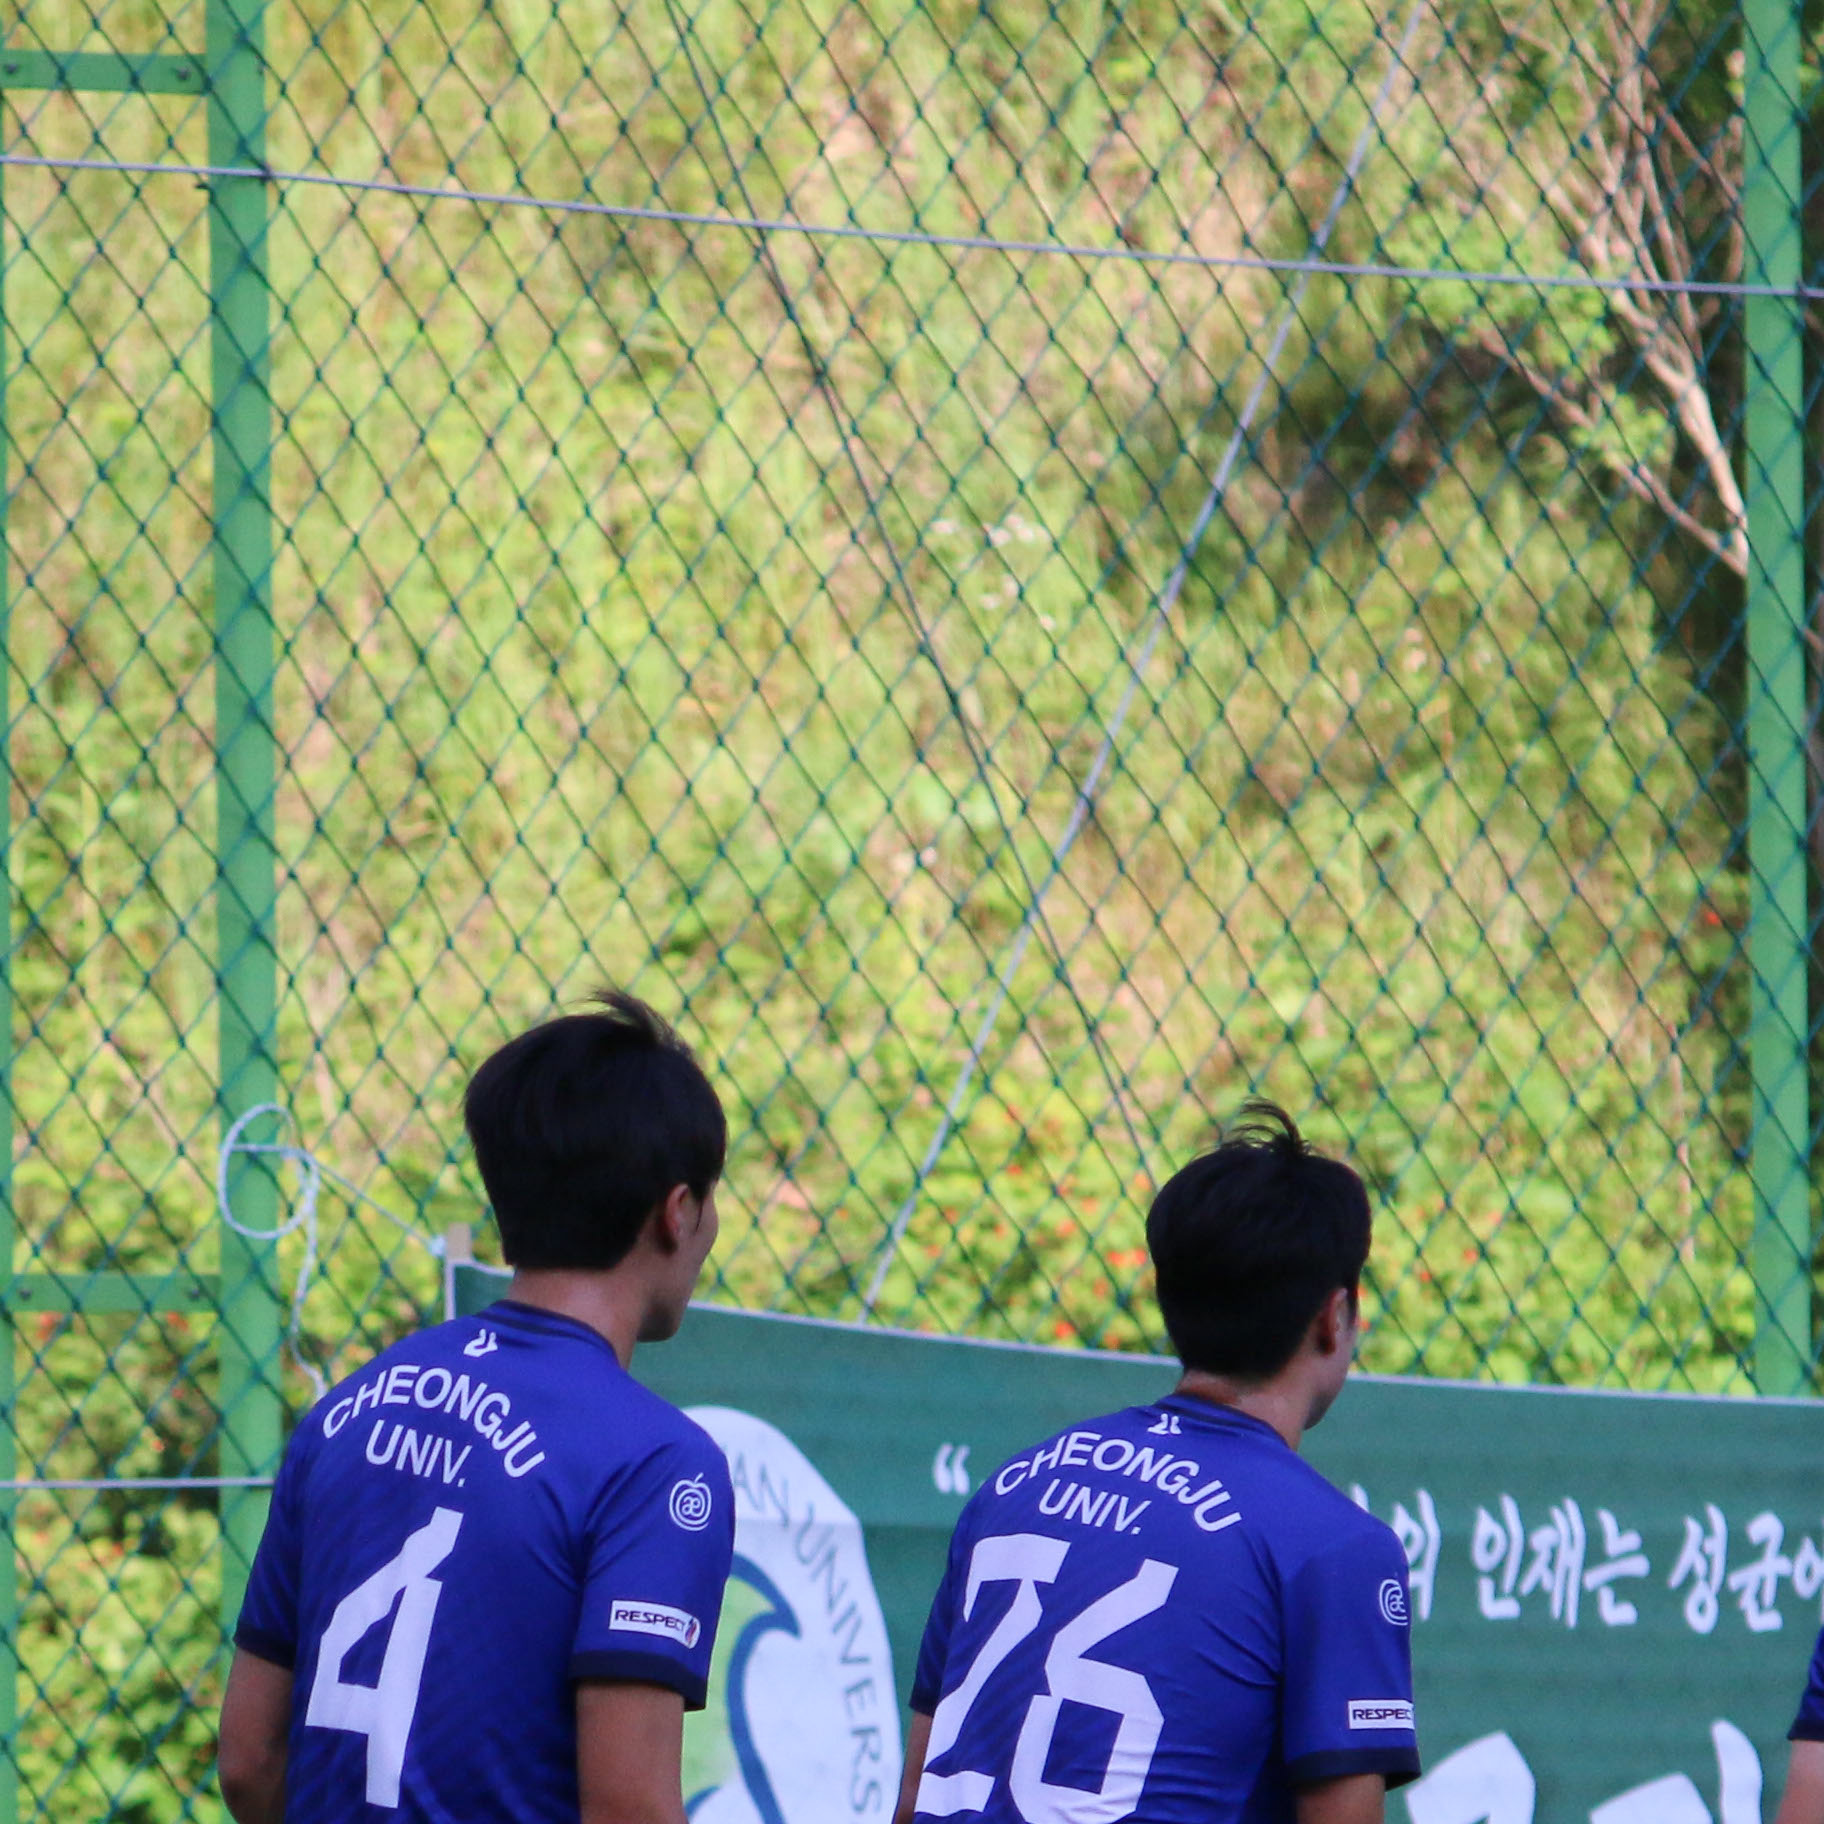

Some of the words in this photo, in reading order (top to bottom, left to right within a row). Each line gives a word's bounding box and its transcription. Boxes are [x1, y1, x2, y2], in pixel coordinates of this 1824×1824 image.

[323, 1364, 546, 1478] CHEONGJU
[366, 1419, 472, 1488] UNIV.
[994, 1431, 1242, 1533] CHEONGJU
[1038, 1478, 1152, 1535] UNIV.
[1472, 1493, 1651, 1628] 인재는
[304, 1506, 464, 1809] 4
